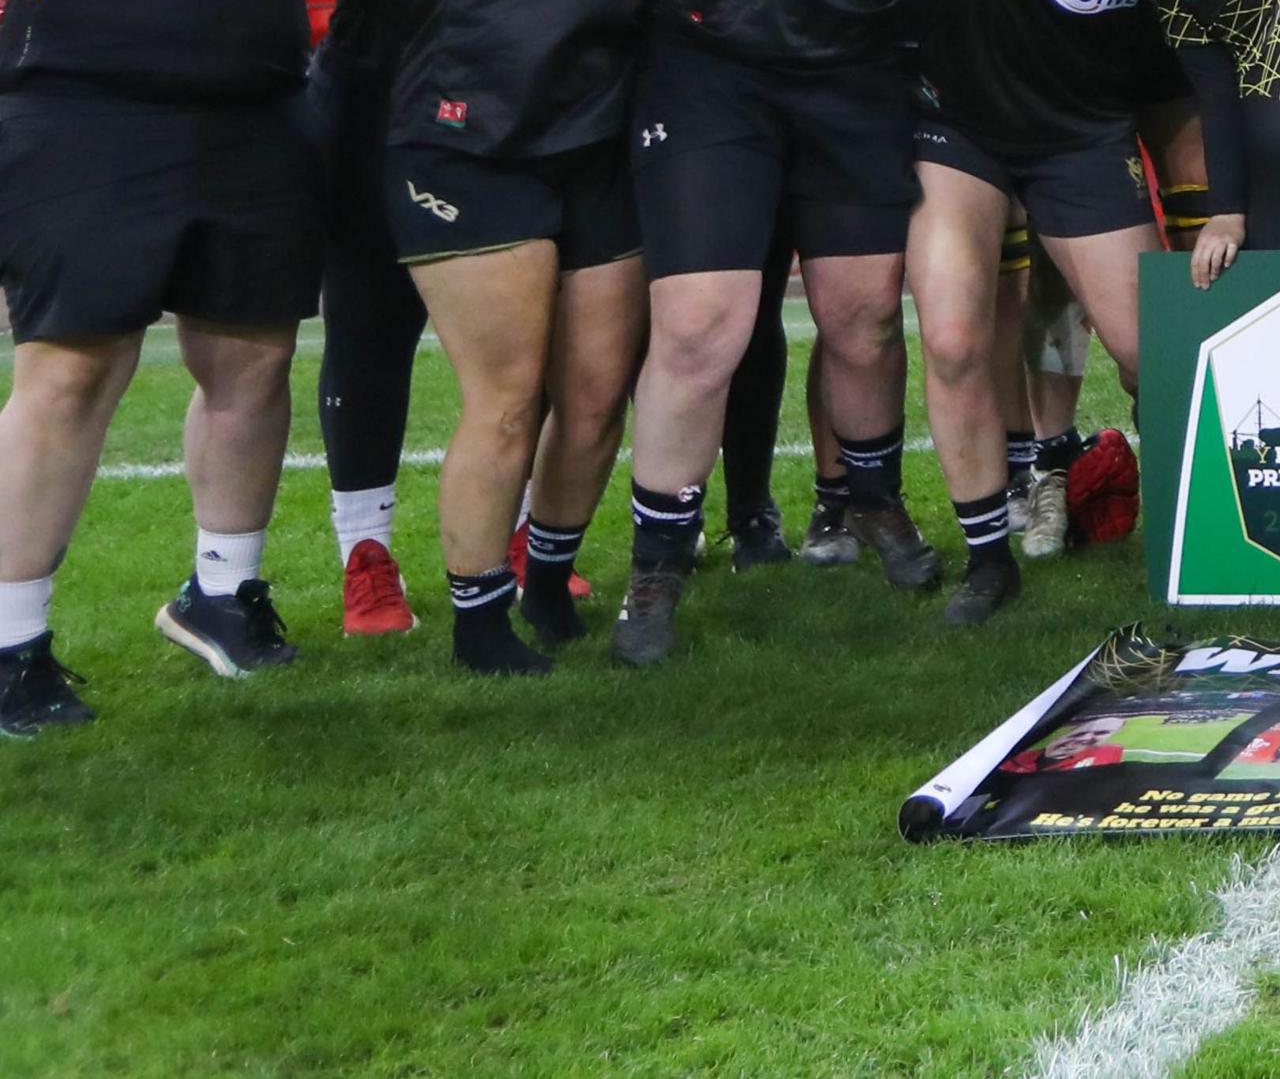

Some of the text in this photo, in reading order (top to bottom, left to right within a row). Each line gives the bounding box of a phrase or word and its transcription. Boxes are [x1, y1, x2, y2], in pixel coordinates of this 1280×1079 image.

[1255, 445, 1271, 464] Y
[1140, 790, 1184, 801] No
[1187, 791, 1271, 803] game
[1113, 802, 1152, 813] he
[1159, 803, 1217, 814] was
[1030, 813, 1094, 826] He's
[1098, 814, 1209, 828] forever
[1213, 818, 1232, 827] a
